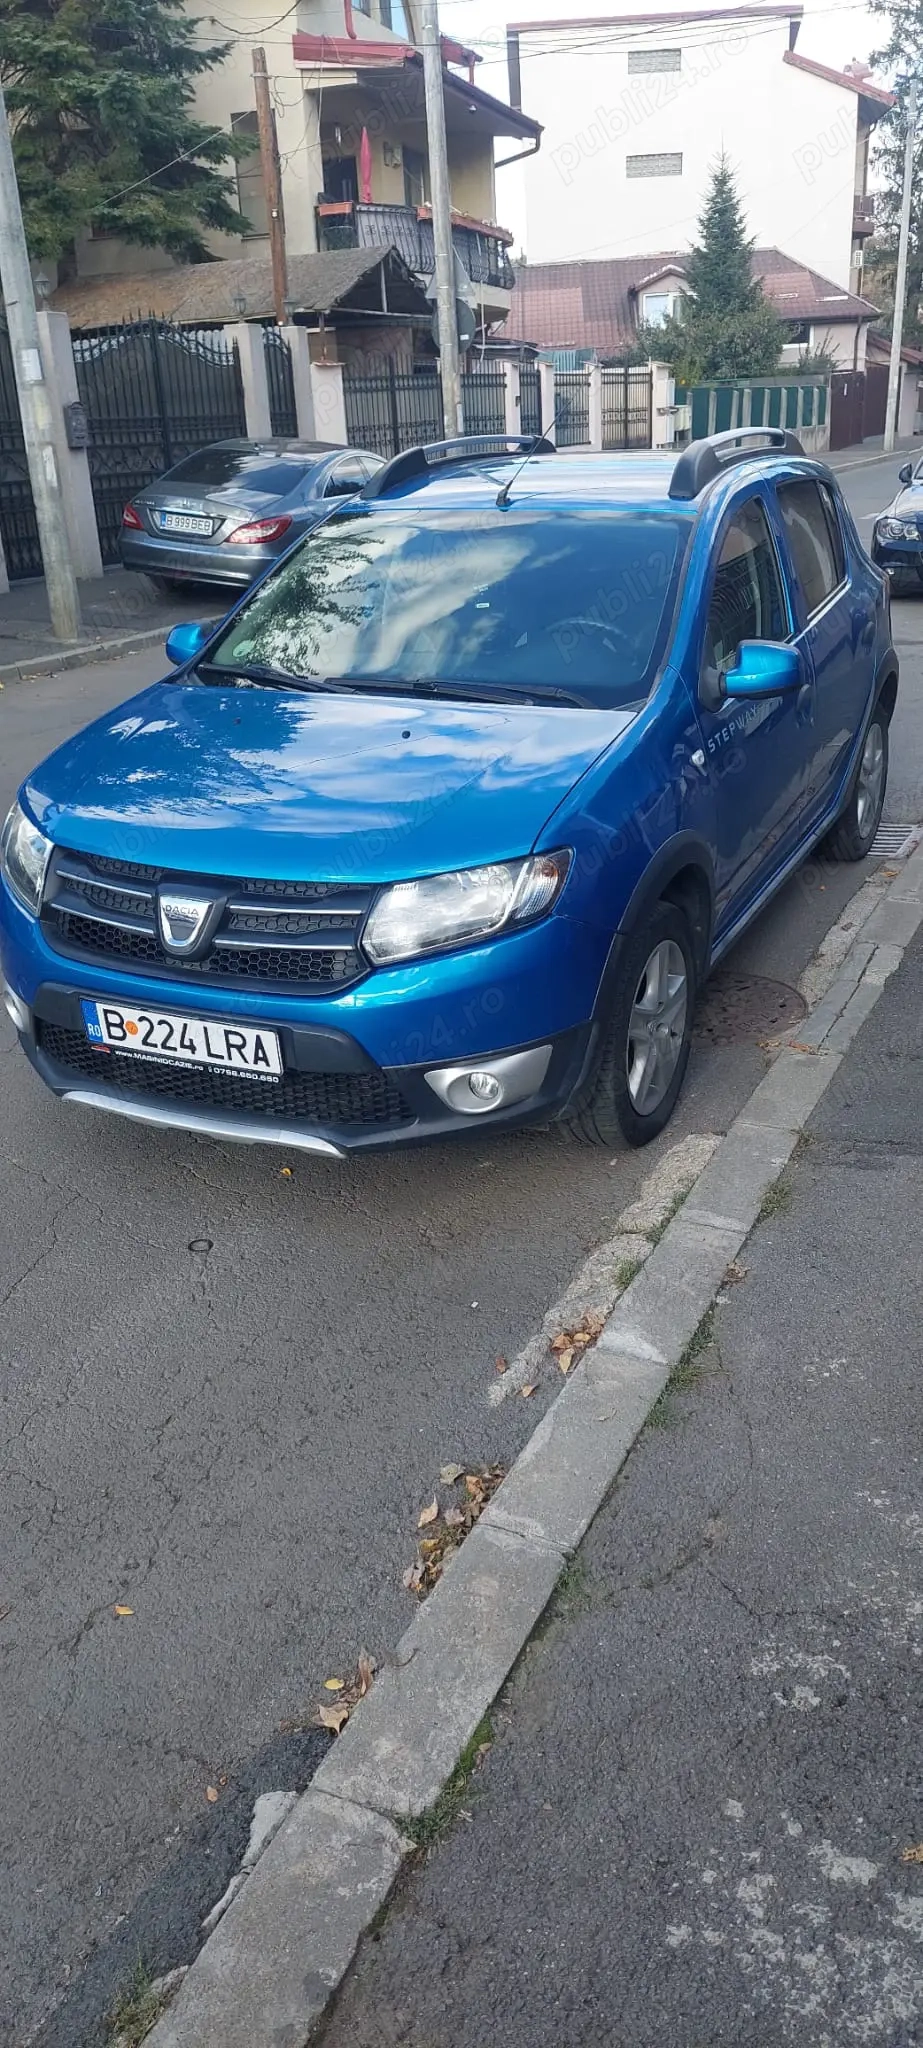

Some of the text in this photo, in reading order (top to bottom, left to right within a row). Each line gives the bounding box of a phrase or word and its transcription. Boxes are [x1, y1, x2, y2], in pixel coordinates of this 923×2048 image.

[708, 704, 757, 753] STEPWAY
[165, 904, 199, 916] DACIA
[87, 1022, 101, 1037] RO
[102, 1008, 271, 1068] B 224 LRA
